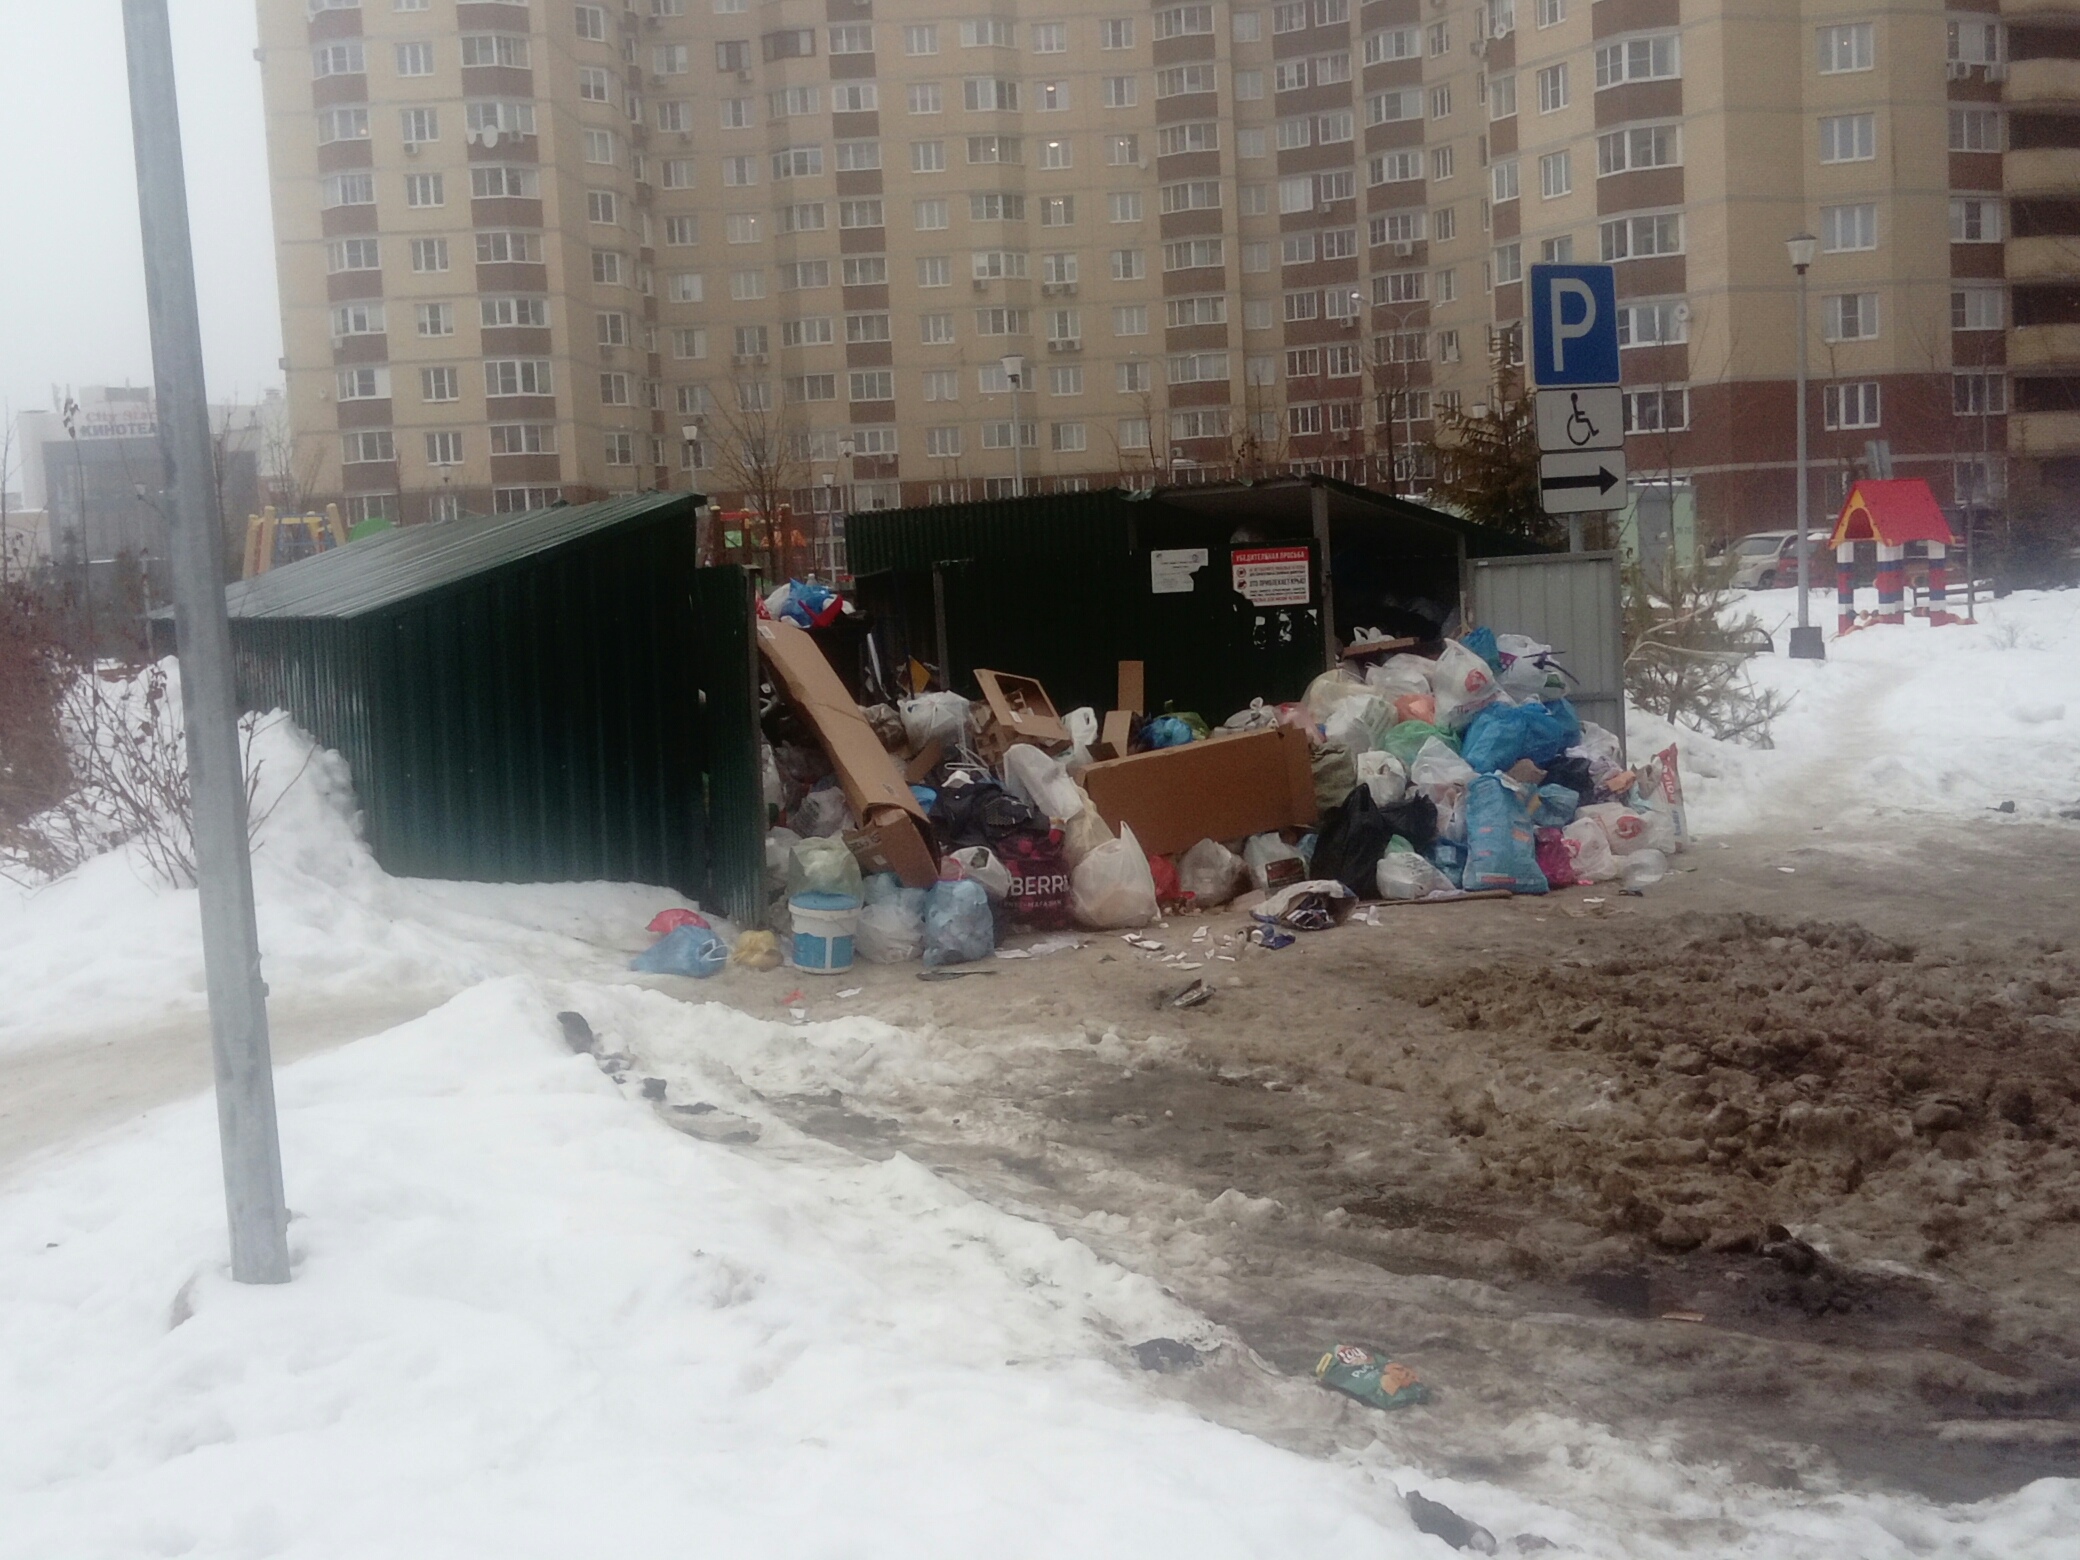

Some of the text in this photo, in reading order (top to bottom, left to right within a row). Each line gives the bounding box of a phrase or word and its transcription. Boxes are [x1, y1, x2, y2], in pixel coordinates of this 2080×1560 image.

[1550, 278, 1596, 372] P
[80, 423, 157, 436] КИНОТЕА
[1236, 551, 1305, 562] УБЕДИТЕЛЬНАЯ ПРОСЬБА
